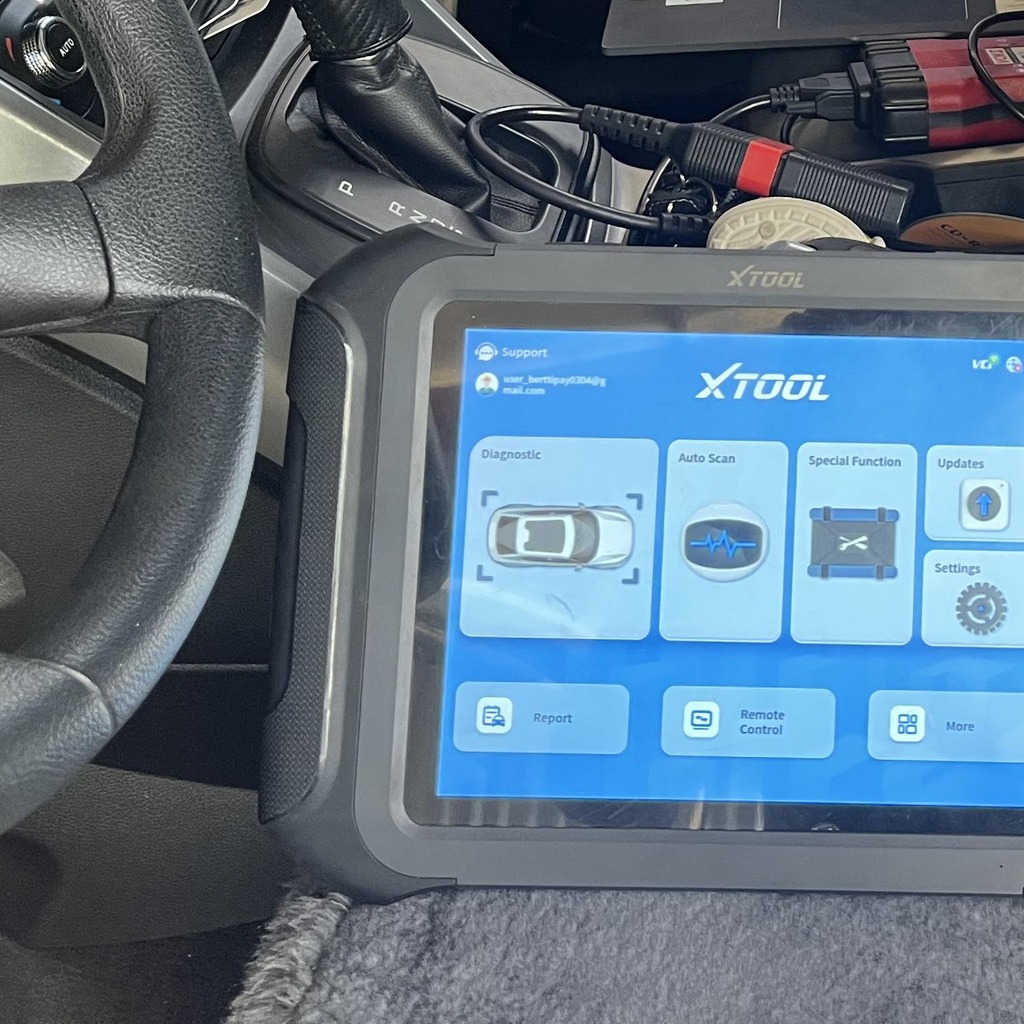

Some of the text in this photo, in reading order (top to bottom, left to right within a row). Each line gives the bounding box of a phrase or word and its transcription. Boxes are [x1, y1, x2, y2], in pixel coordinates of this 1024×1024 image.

[59, 37, 75, 57] AUTO
[338, 180, 428, 223] P R N
[726, 264, 805, 289] XTOOL
[502, 347, 548, 359] Support
[694, 362, 831, 402] XTOOL
[502, 386, 546, 395] mail.com
[481, 449, 542, 462] Diagnostic
[678, 453, 736, 465] Auto Scan
[808, 455, 902, 469] Special Function
[938, 458, 985, 472] Updates
[935, 563, 981, 577] Settings
[533, 712, 573, 727] Report
[740, 709, 786, 721] Remote
[740, 723, 783, 736] Control
[946, 720, 975, 733] More
